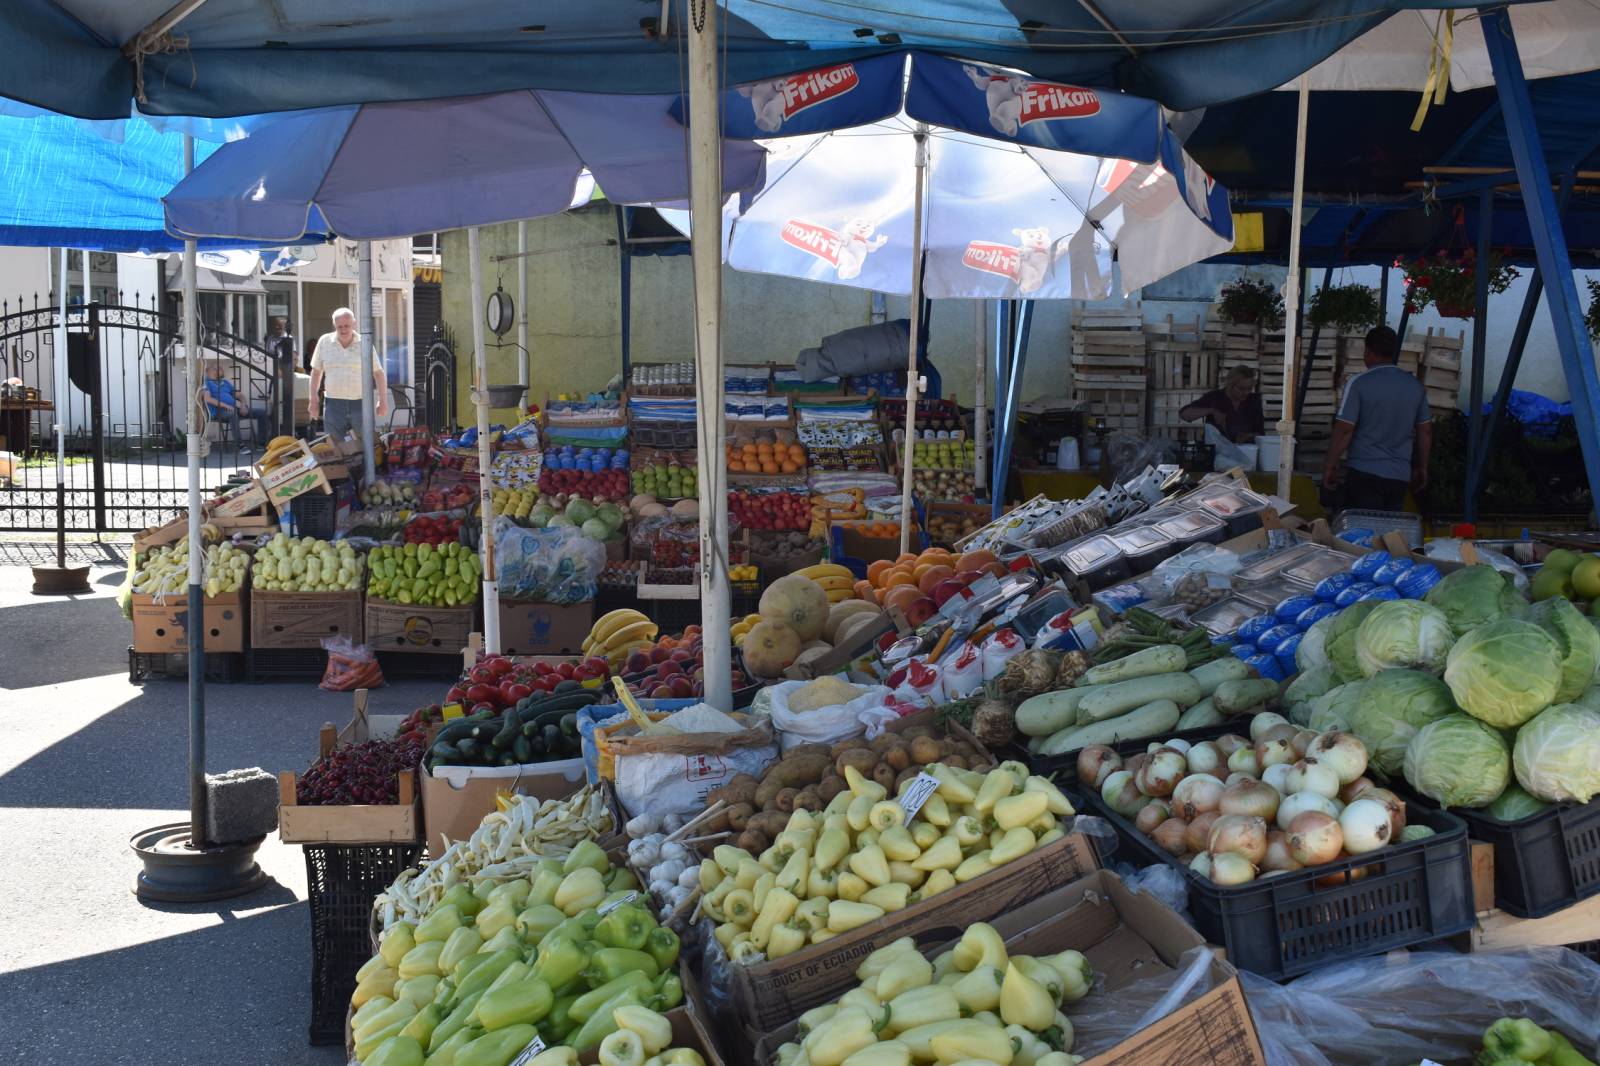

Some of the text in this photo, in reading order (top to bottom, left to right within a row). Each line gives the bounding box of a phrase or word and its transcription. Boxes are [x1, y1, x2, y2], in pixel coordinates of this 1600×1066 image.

[782, 65, 855, 108] Frikom
[1021, 88, 1099, 114] Frikom
[755, 941, 876, 993] RODUCT OF ECUADOR
